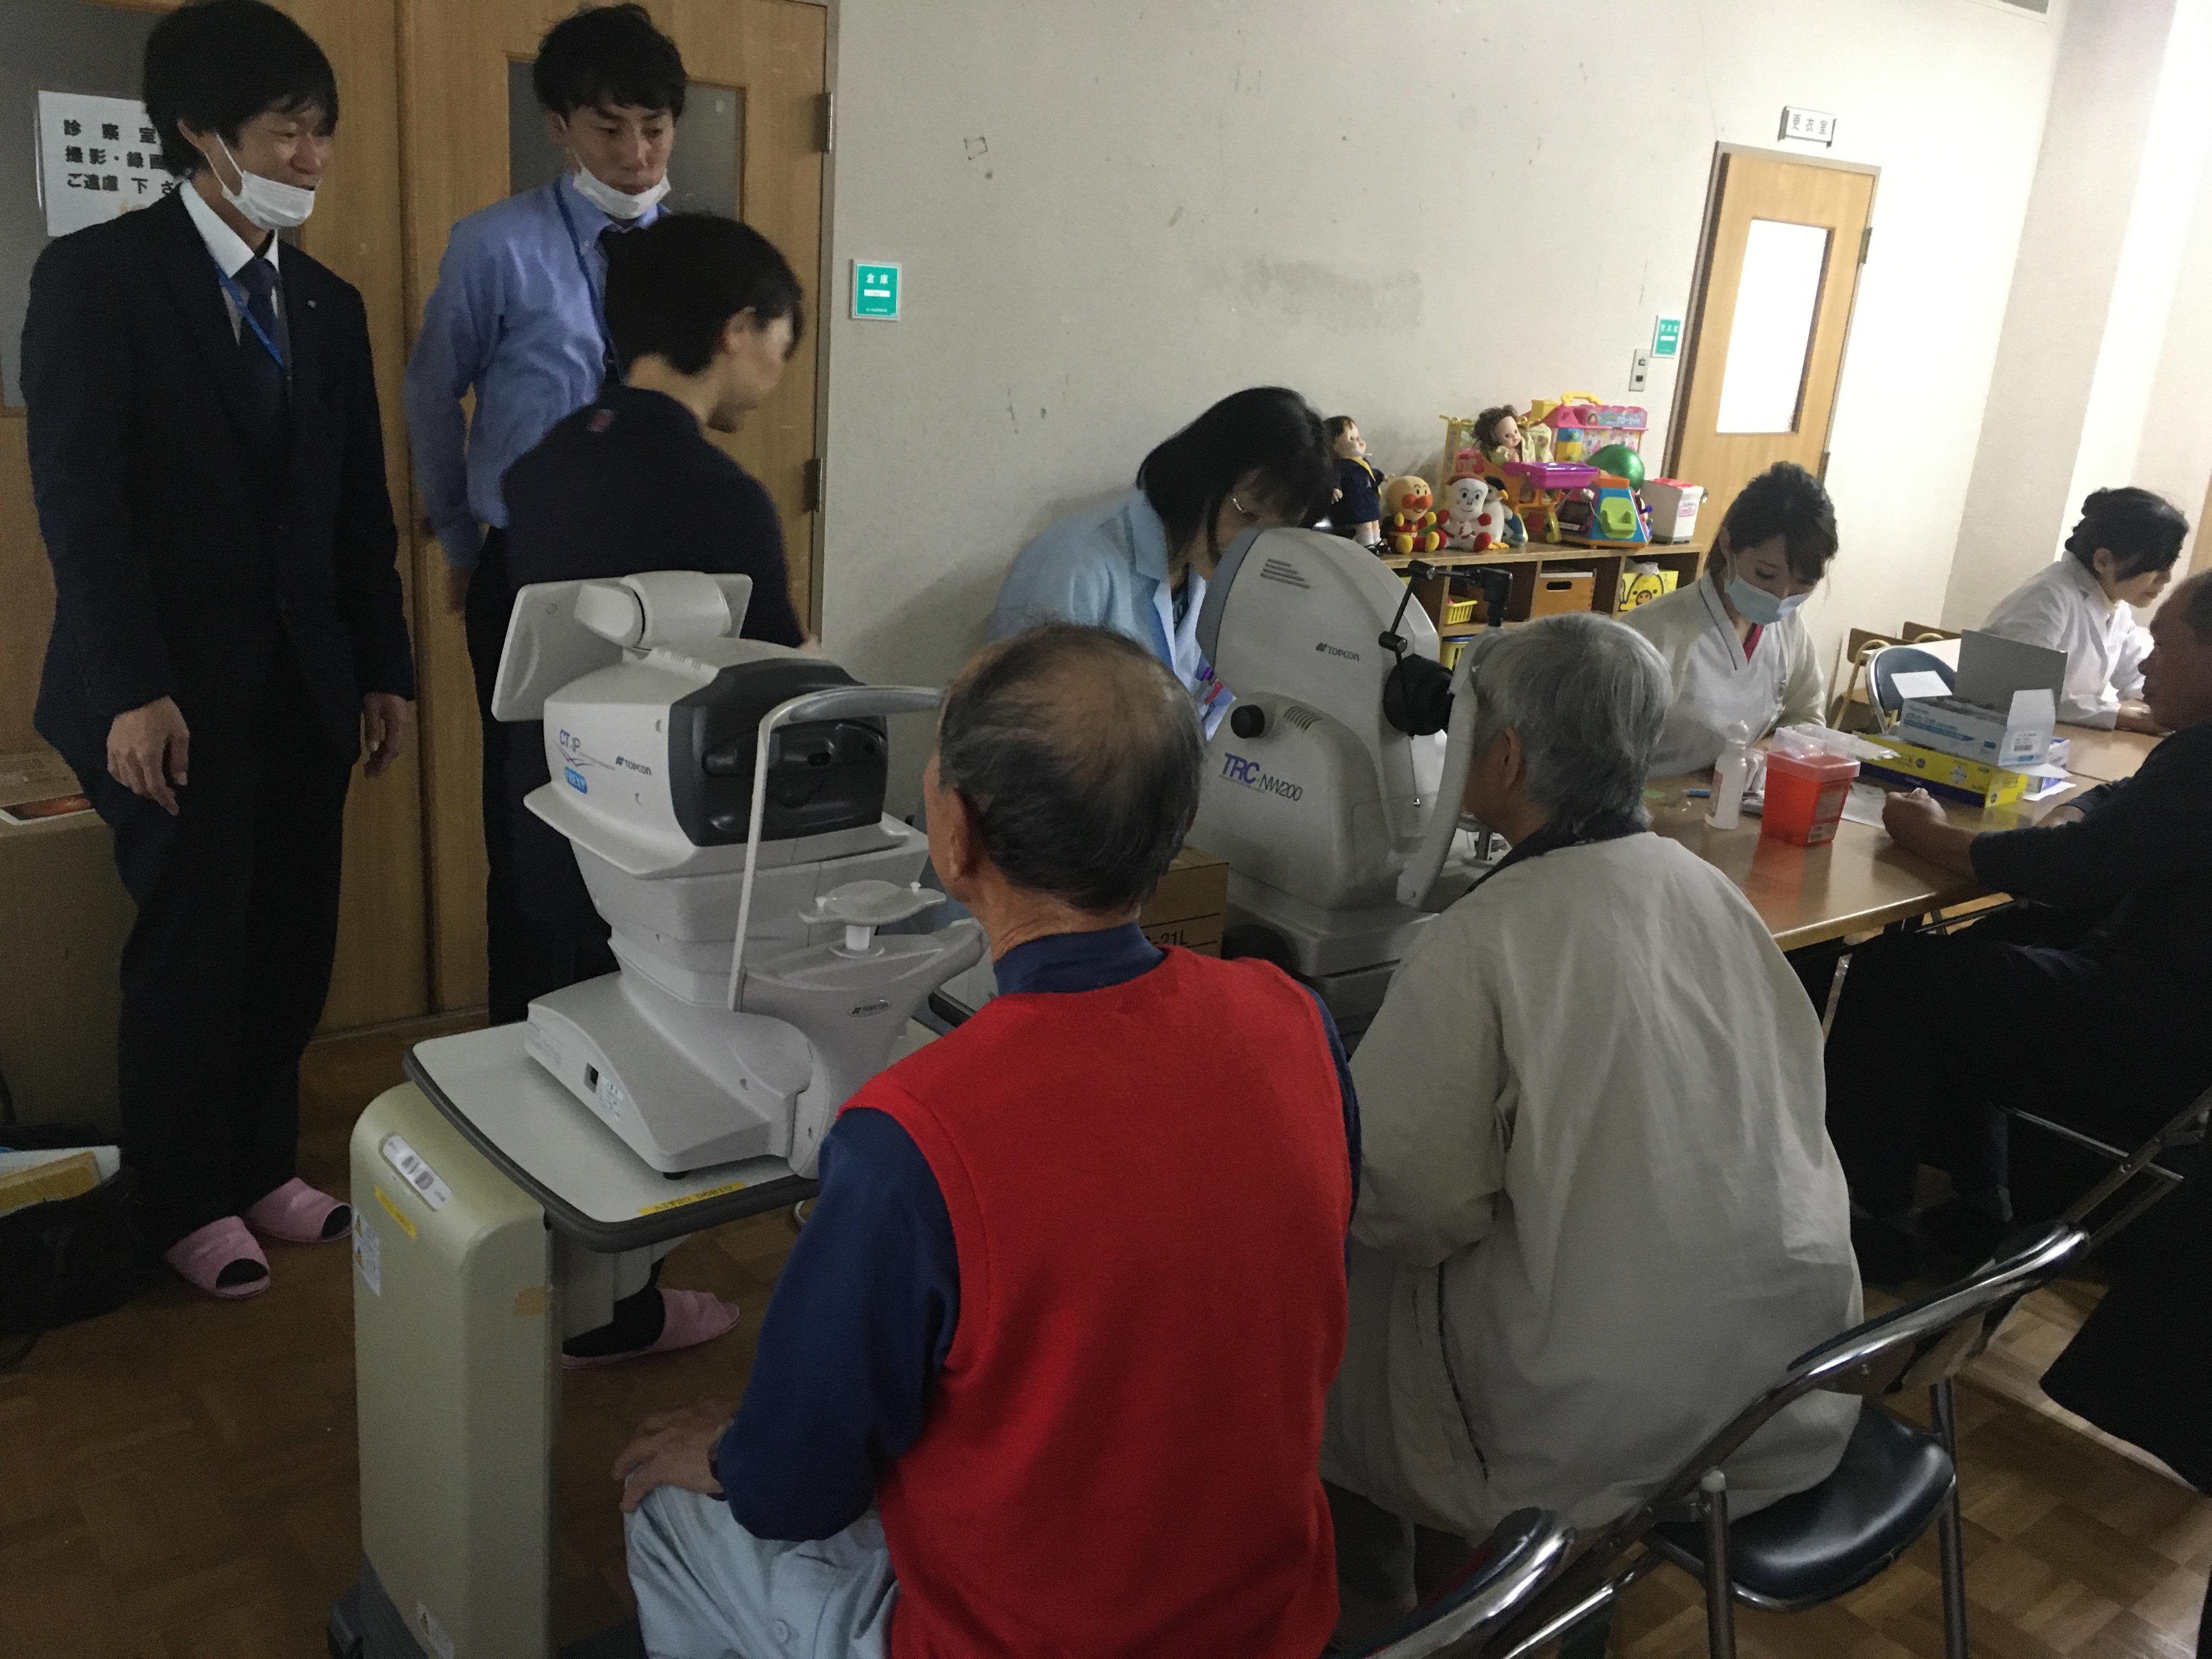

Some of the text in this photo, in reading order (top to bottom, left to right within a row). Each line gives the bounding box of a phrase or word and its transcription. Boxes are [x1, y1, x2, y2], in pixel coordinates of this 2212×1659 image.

[1792, 114, 1827, 135] 更衣室
[1328, 646, 1359, 662] TOPCON
[624, 759, 652, 776] TOPCON
